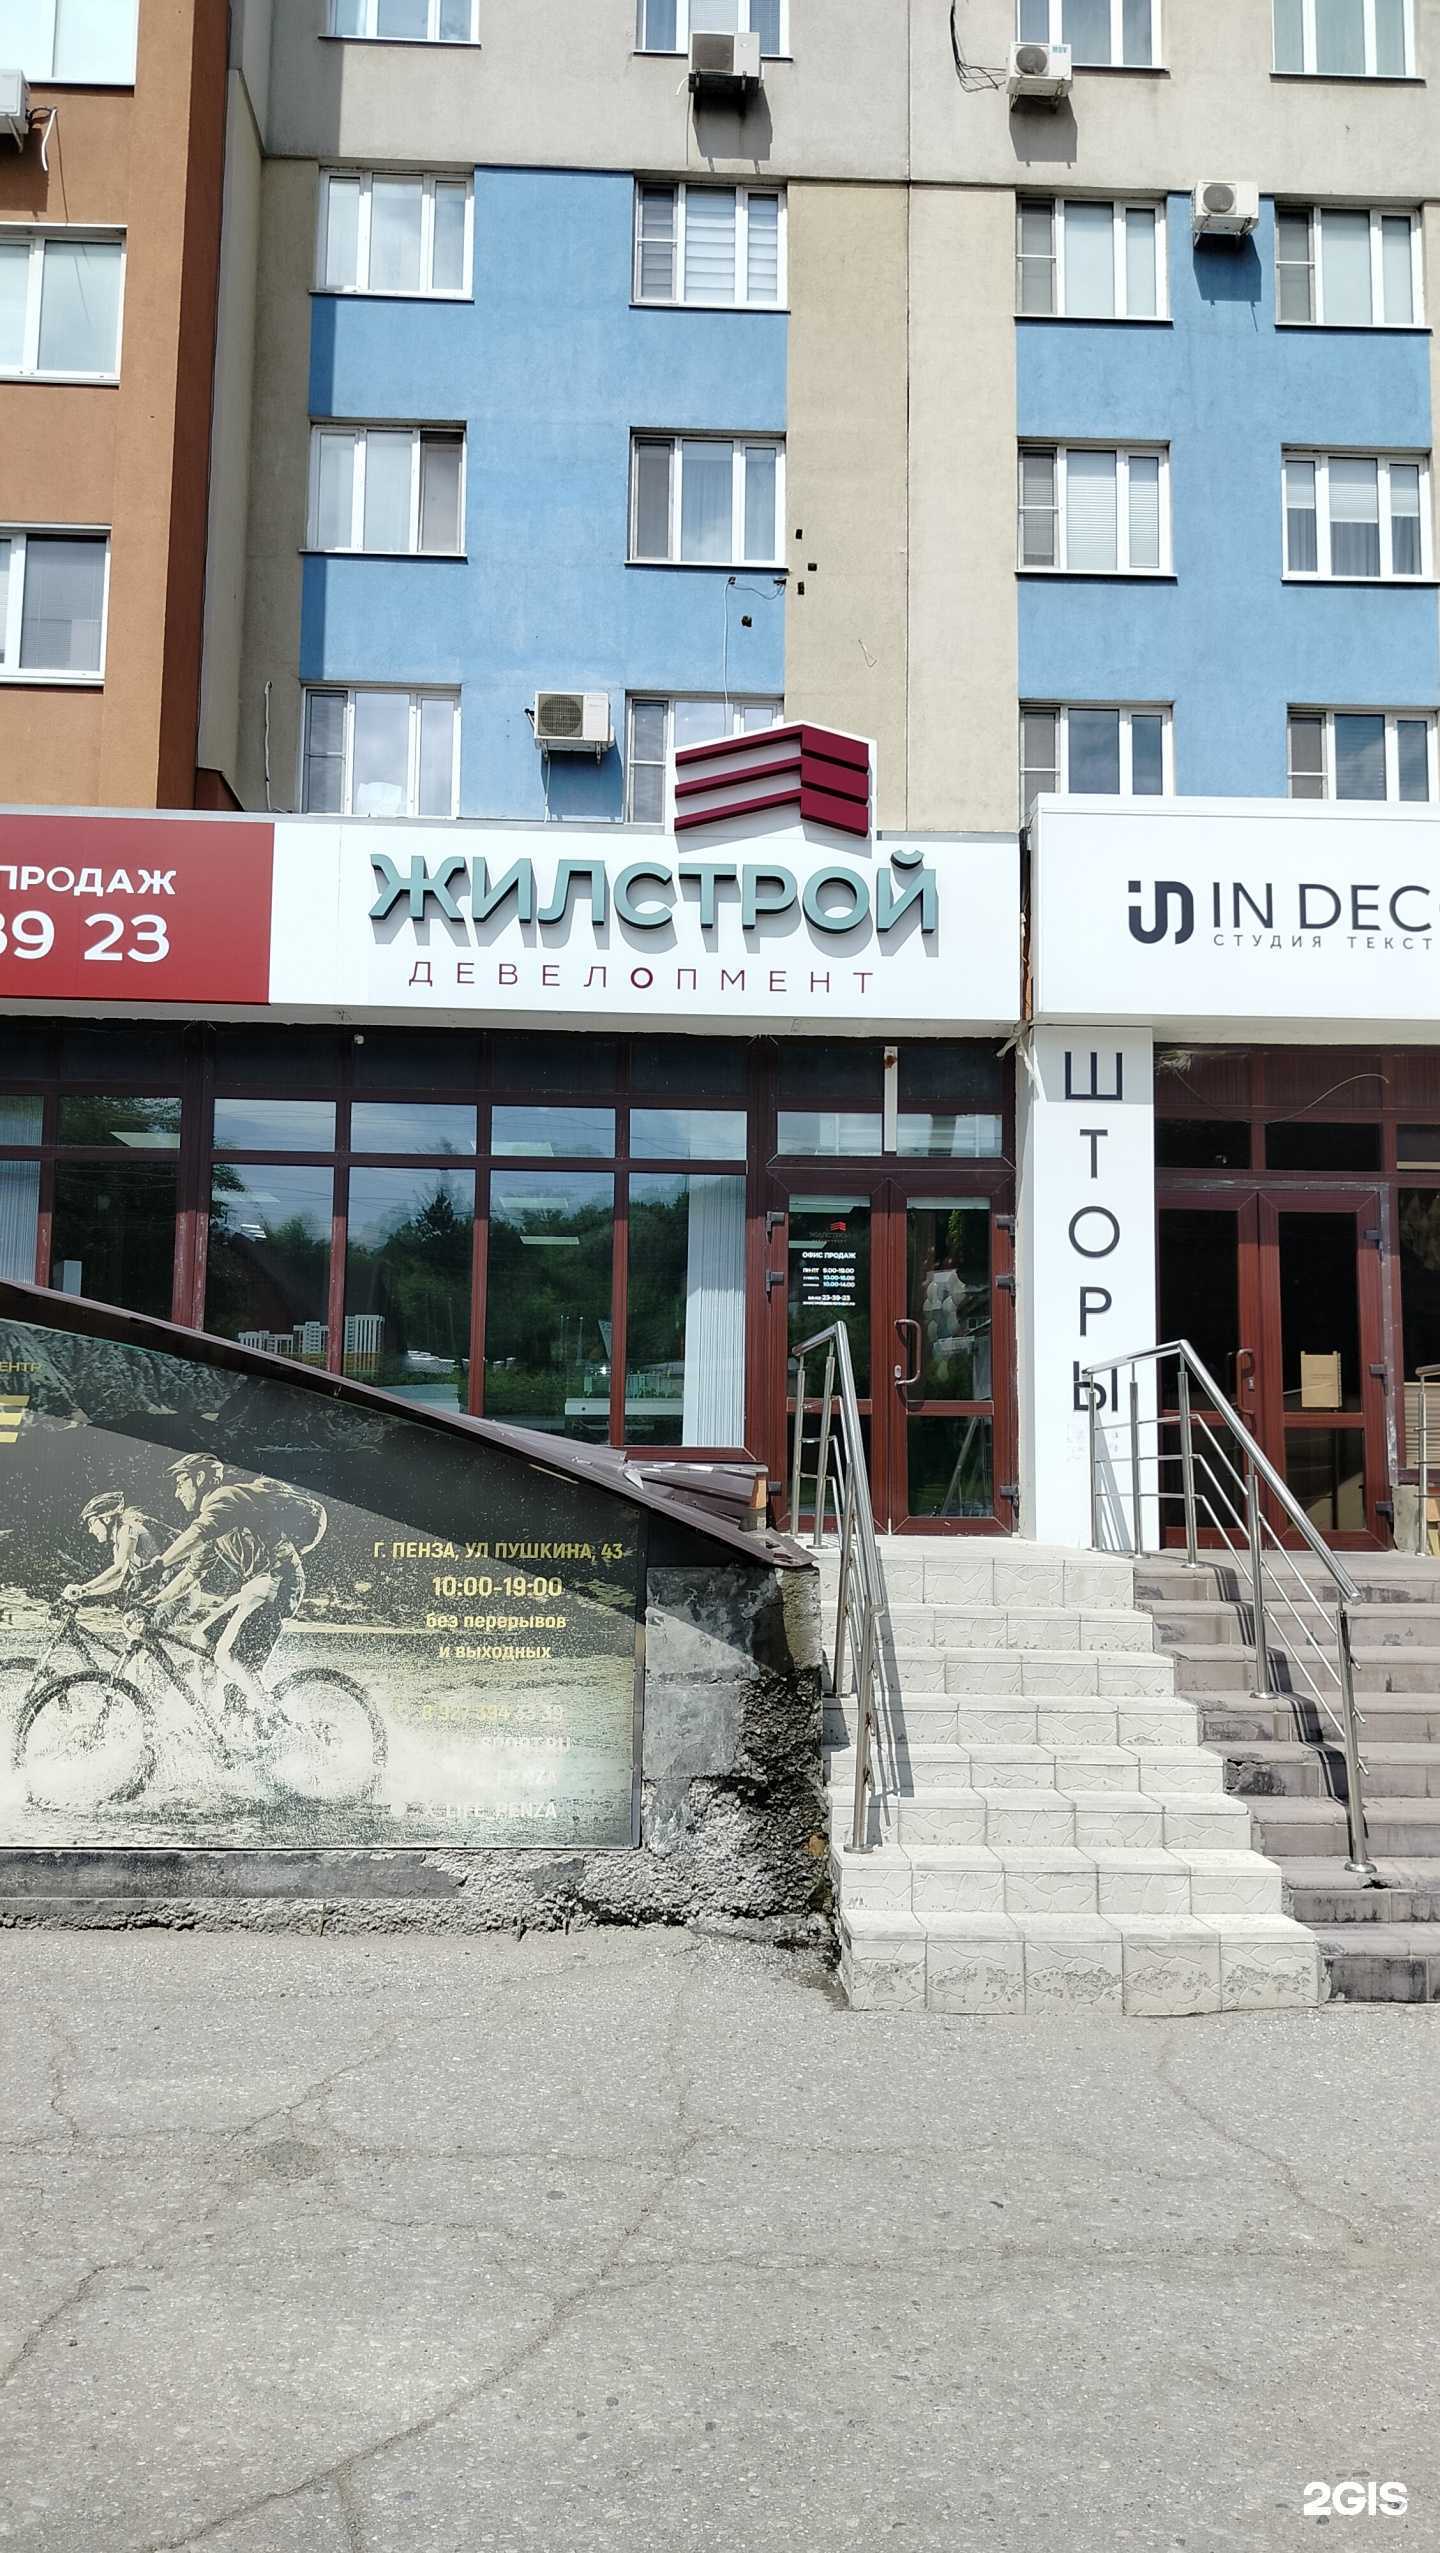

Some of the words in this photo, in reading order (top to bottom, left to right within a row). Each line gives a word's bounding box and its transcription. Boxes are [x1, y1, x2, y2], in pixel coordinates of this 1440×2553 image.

[0, 865, 177, 896] ПРОДАЖ
[369, 848, 937, 935] ЖИЛСТРОЙ
[1213, 882, 1273, 929] IN
[1299, 883, 1440, 933] DEC
[0, 910, 55, 960] 9
[84, 913, 170, 963] 23
[1213, 934, 1322, 950] СТУДИЯ
[409, 961, 874, 994] ДЕВЕЛОПМЕНТ
[1064, 1051, 1123, 1413] ШТОРЫ
[802, 1251, 823, 1259] ОФИС
[824, 1252, 856, 1260] ПРОДАЖ
[373, 1542, 386, 1558] Г.
[392, 1542, 459, 1561] ПЕНЗА,
[465, 1543, 489, 1558] УЛ
[495, 1543, 598, 1562] ПУШКИНА,
[601, 1543, 624, 1560] 43
[432, 1576, 563, 1597] 10:00-19:00
